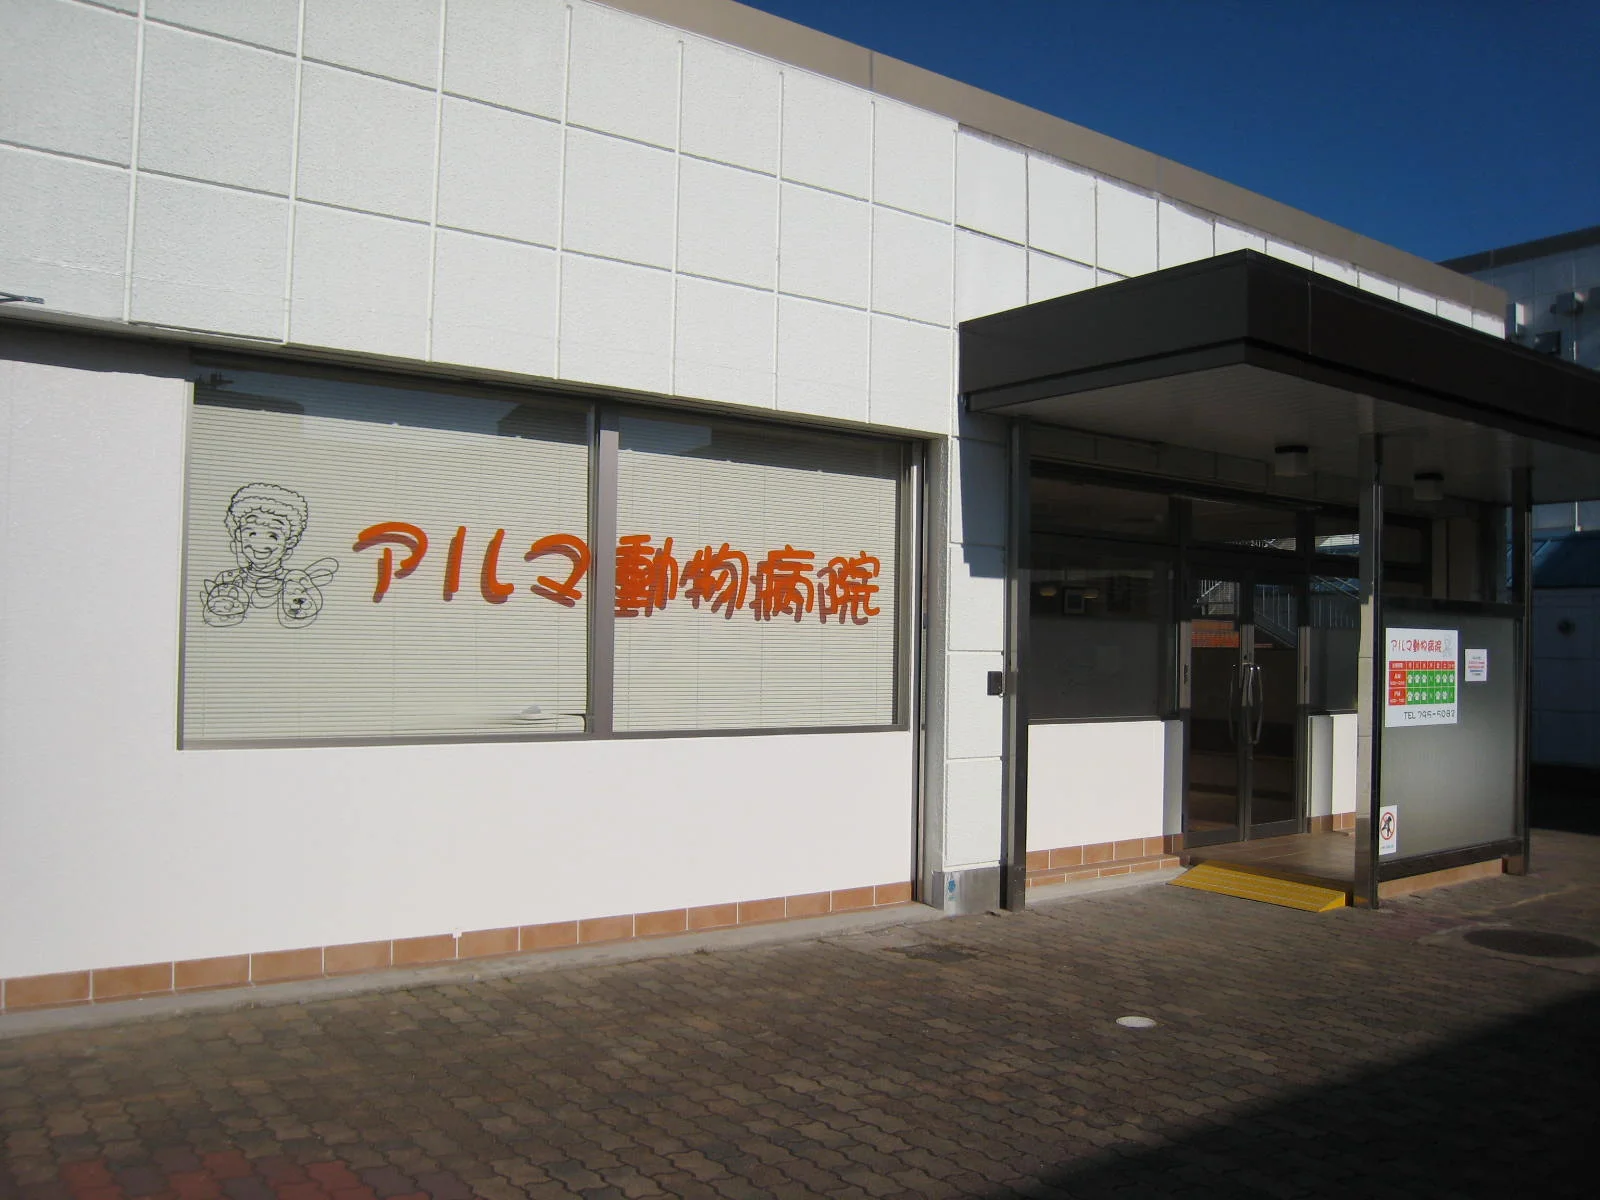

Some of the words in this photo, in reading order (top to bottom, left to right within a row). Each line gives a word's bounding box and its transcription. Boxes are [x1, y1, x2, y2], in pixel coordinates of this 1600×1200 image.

[353, 521, 880, 623] アルマ動物病院
[1403, 711, 1416, 720] TEL
